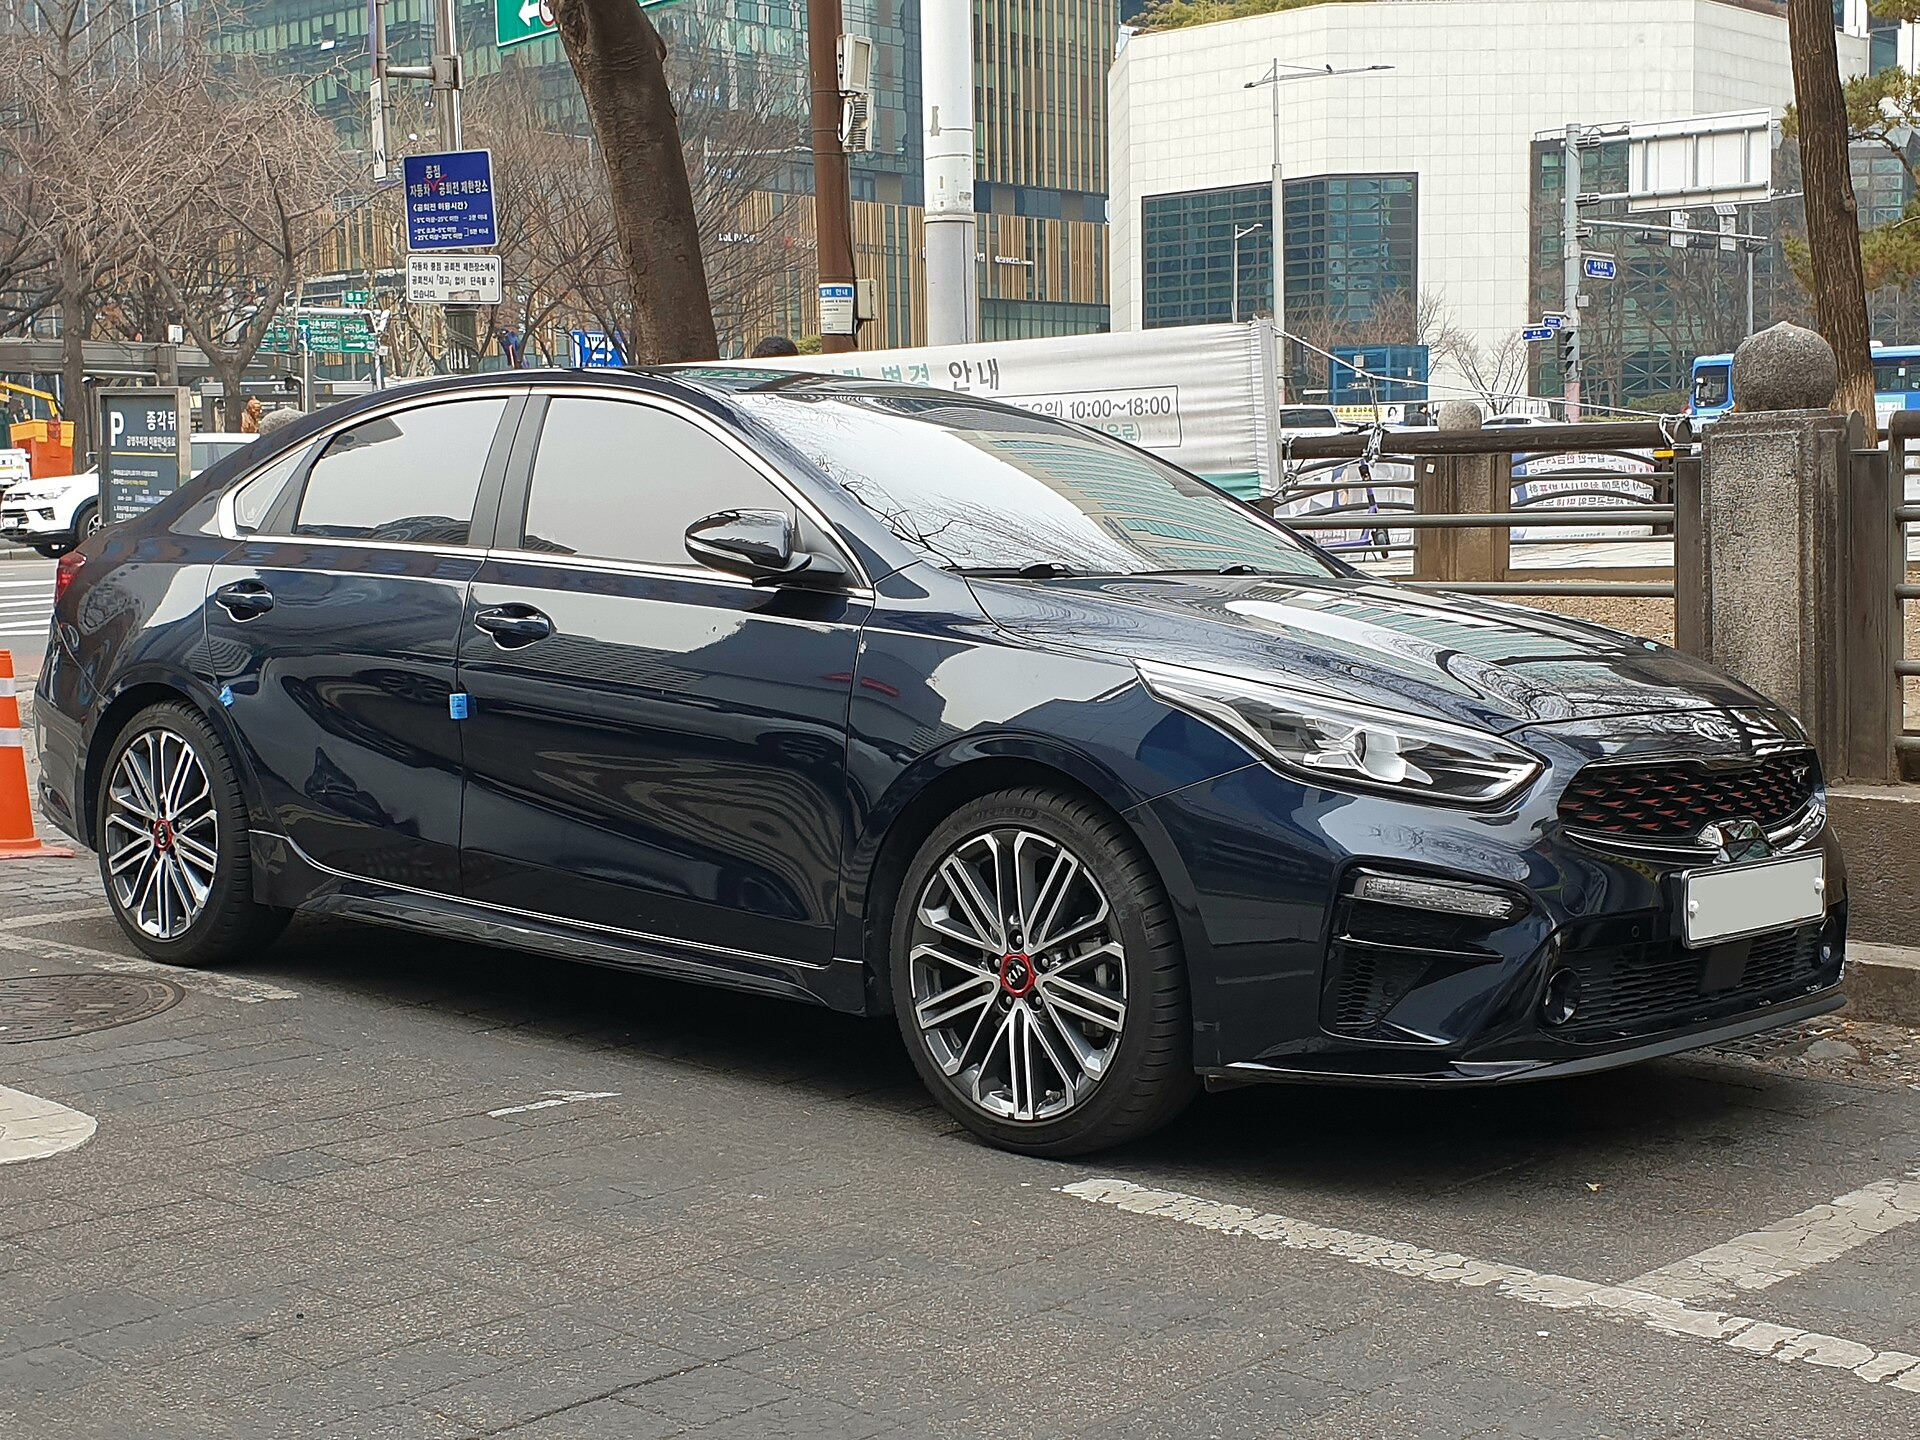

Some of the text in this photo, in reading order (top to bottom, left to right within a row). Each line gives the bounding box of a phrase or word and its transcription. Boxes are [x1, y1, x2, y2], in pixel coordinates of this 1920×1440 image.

[425, 164, 441, 179] 중점
[410, 179, 489, 198] 자동차 공회전 제한장소
[411, 262, 428, 272] 자동차
[444, 262, 461, 272] 공회전
[463, 262, 496, 272] 제한장소에서
[489, 276, 496, 286] 수
[948, 357, 1000, 391] 안내
[1069, 395, 1171, 420] 10:00~18:00
[109, 410, 177, 447] P 종각뒤
[1005, 964, 1026, 986] KIA
